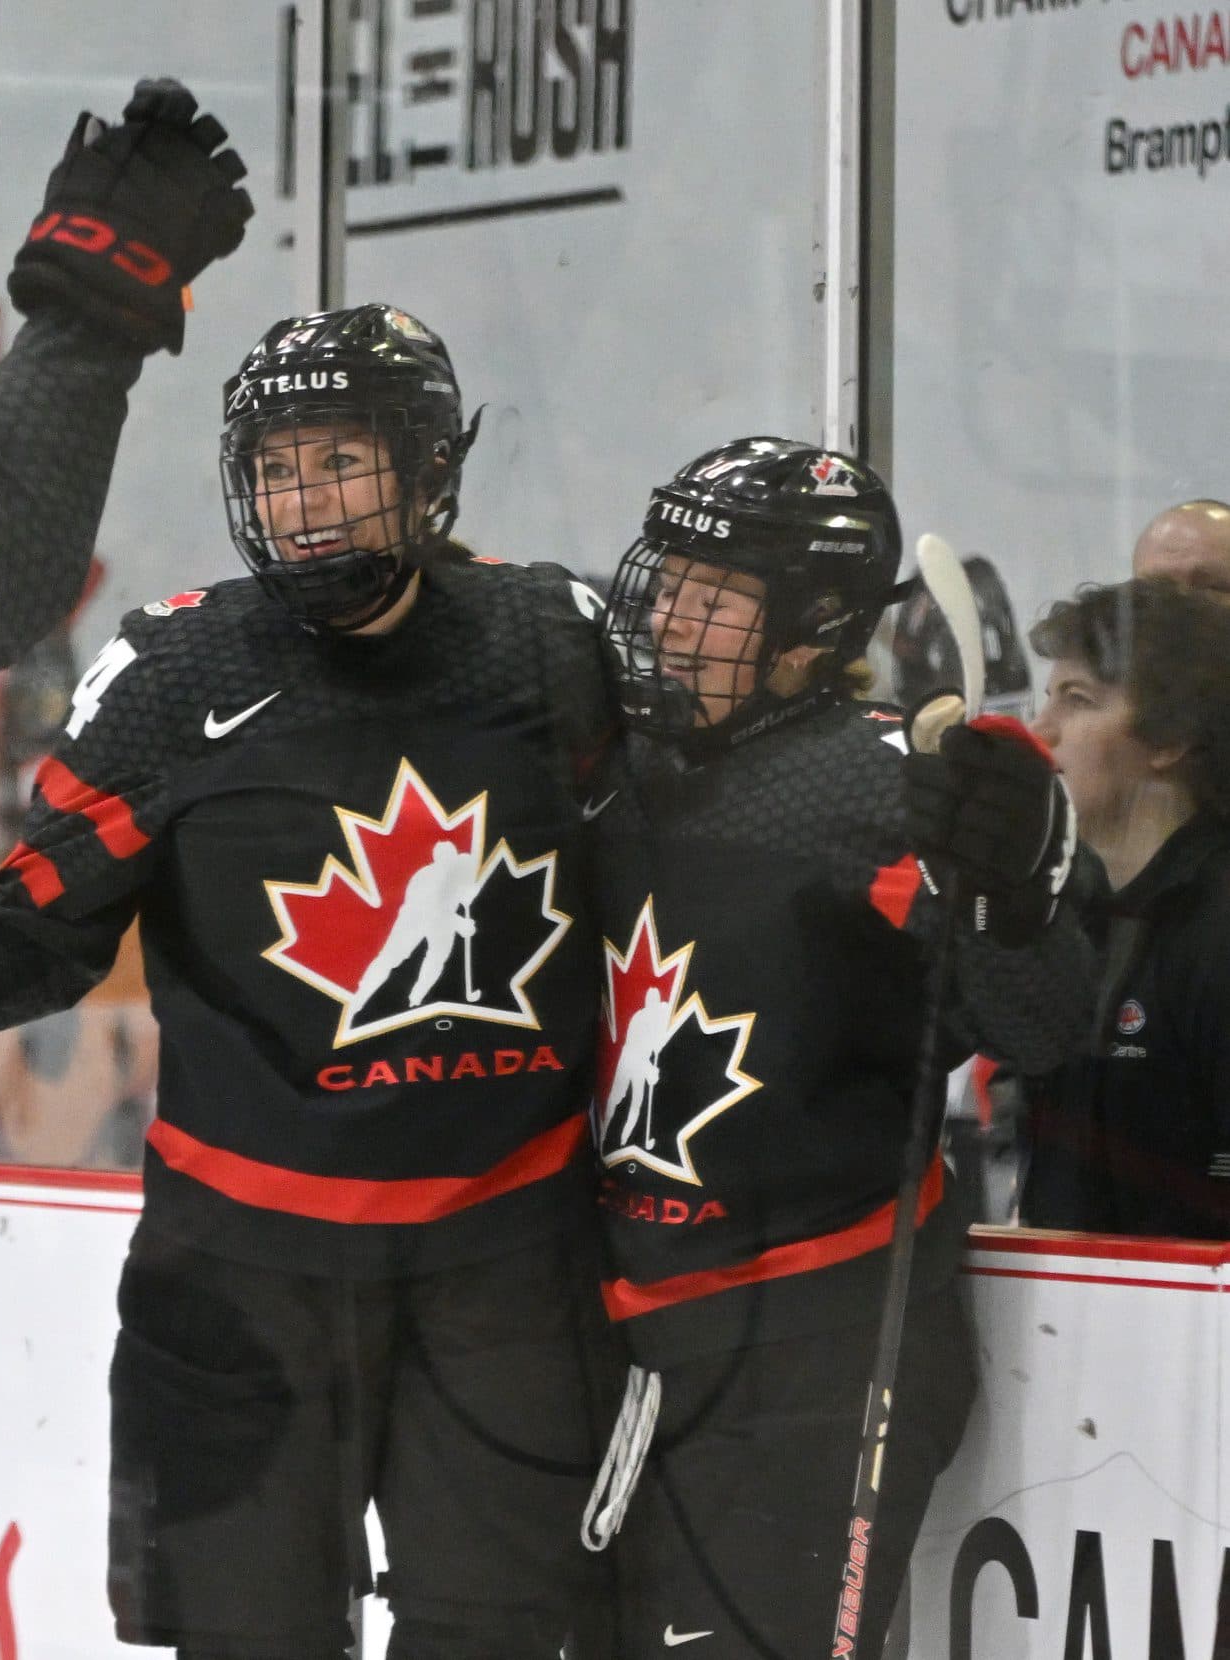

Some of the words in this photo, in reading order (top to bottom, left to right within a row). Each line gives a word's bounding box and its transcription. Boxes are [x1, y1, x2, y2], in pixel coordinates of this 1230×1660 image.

[1121, 10, 1230, 80] CANA
[260, 371, 350, 396] TELUS
[659, 502, 732, 540] TELUS
[316, 1044, 565, 1092] CANADA
